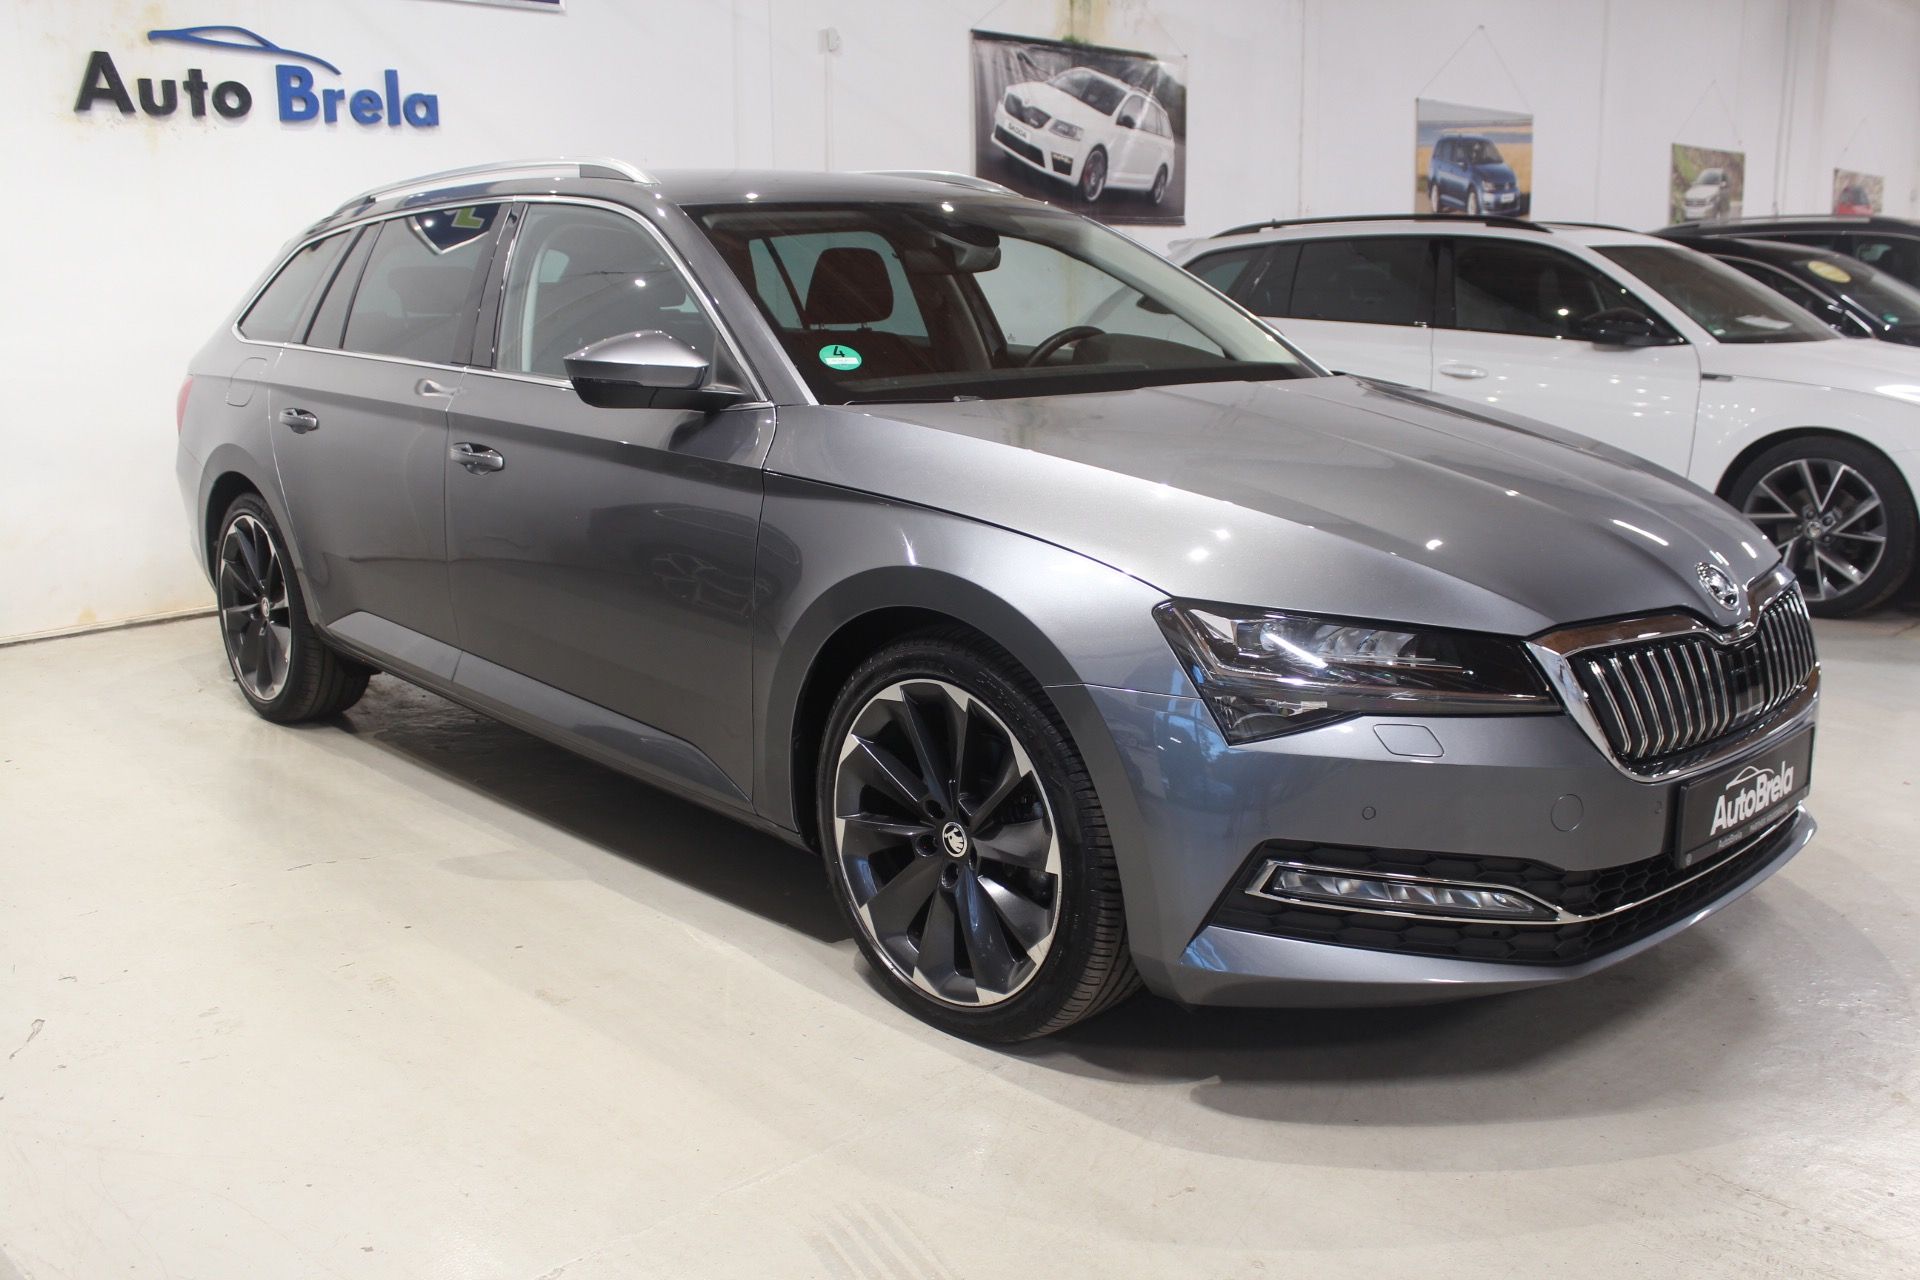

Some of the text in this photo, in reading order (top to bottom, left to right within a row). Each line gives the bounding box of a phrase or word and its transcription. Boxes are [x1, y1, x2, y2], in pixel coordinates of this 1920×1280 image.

[74, 51, 440, 127] Auto Brela
[833, 346, 845, 358] 4
[1709, 760, 1794, 836] AutoBrela
